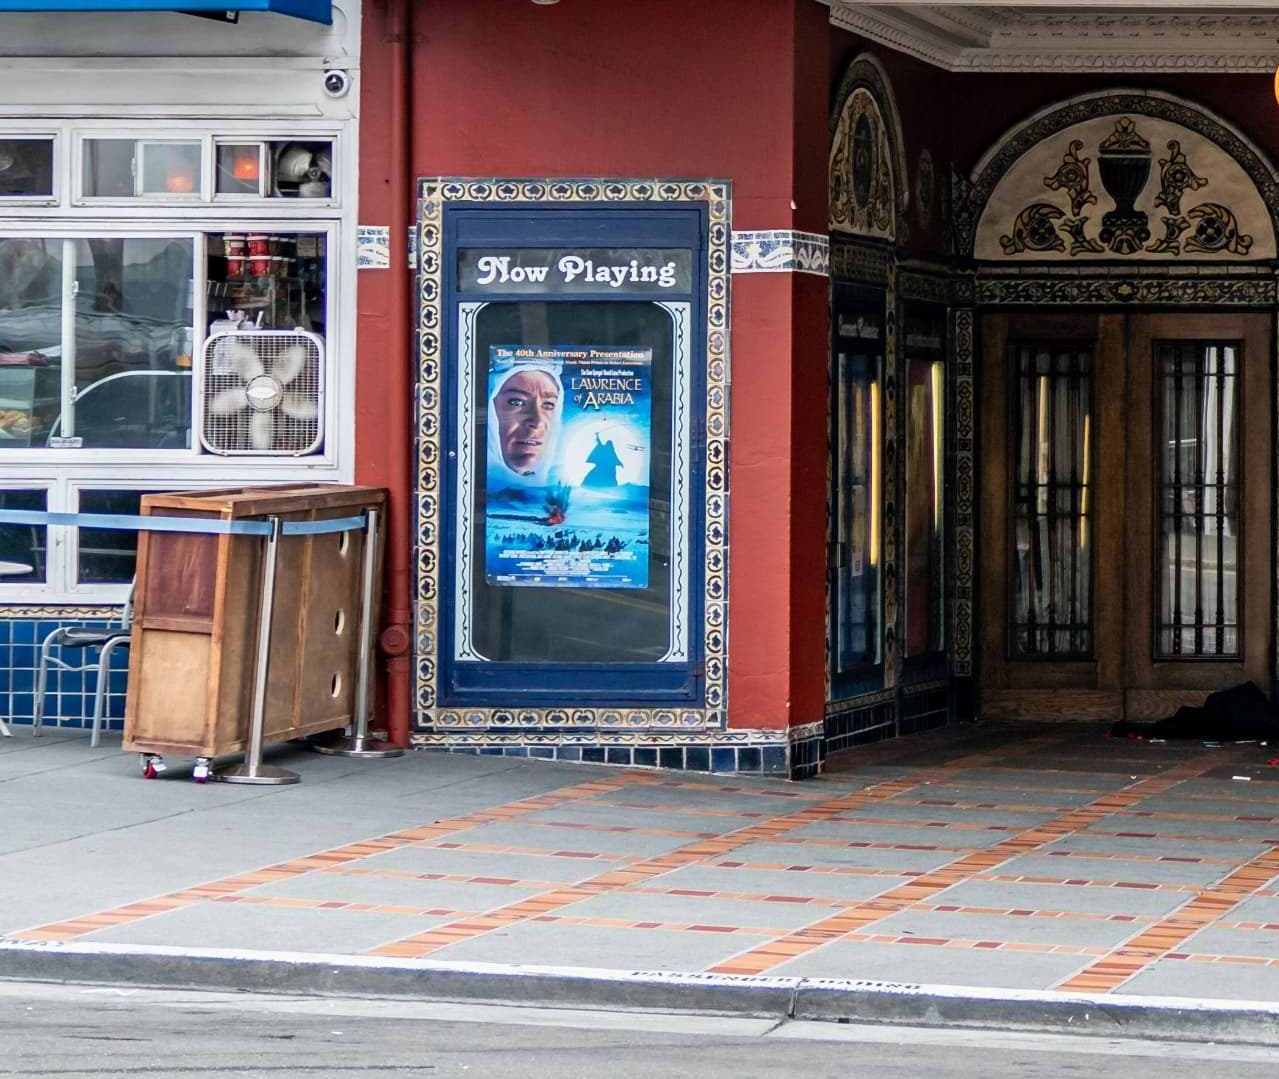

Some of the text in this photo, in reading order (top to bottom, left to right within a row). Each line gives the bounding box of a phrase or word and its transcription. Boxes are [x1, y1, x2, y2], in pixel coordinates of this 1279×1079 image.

[477, 255, 677, 288] Now Playing
[497, 349, 644, 359] The 40th Anniversary Presentation
[571, 378, 642, 391] LAWRENCE
[574, 391, 634, 410] of ARABIA
